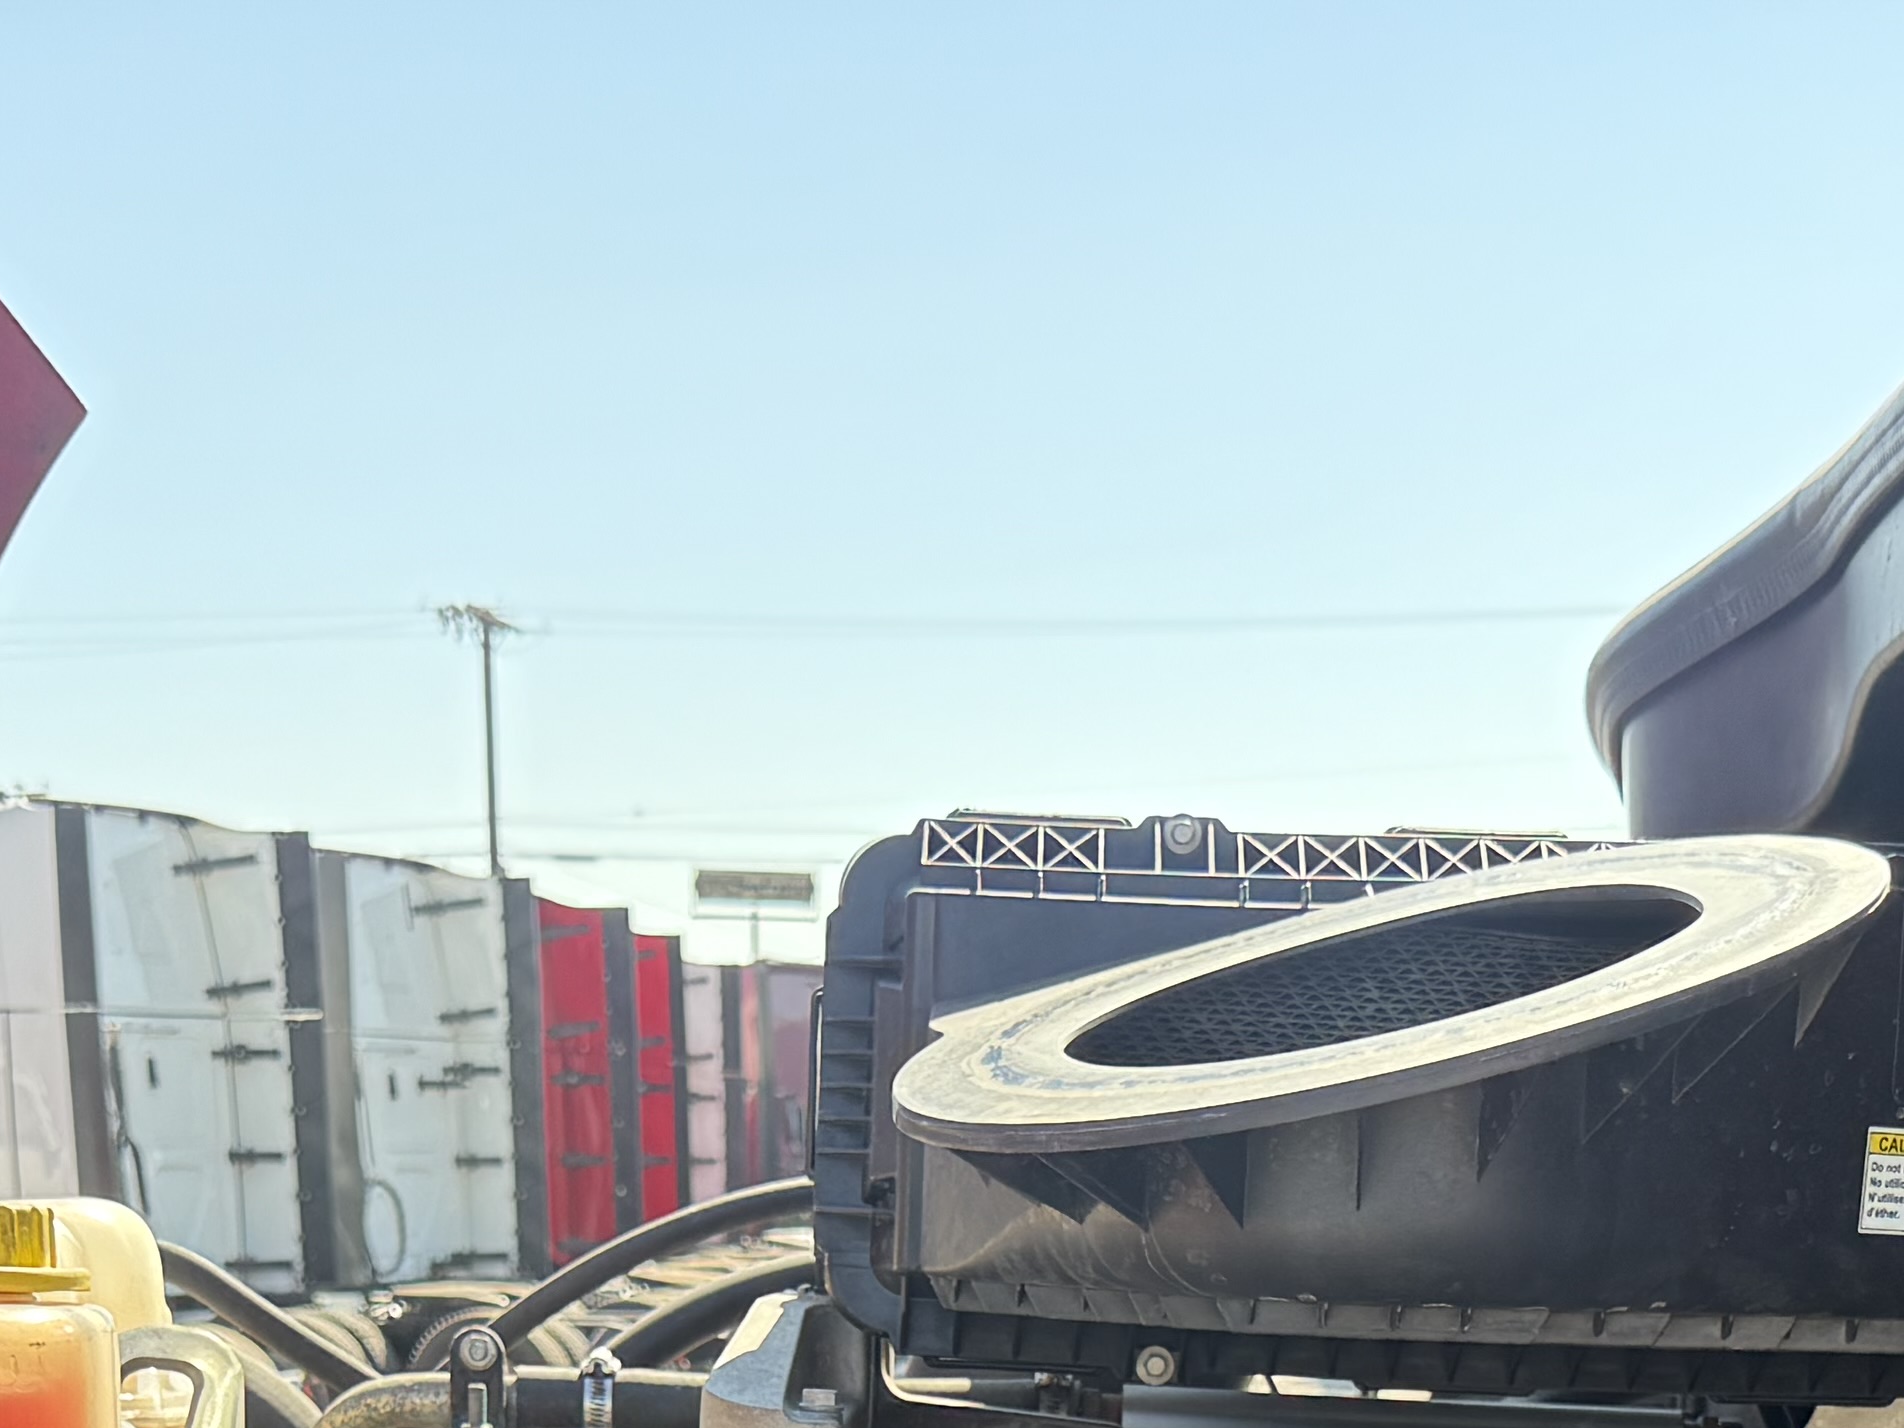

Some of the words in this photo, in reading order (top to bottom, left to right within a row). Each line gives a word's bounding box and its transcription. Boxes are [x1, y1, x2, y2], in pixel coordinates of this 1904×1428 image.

[1871, 1162, 1884, 1173] Do
[1886, 1163, 1901, 1174] not
[1870, 1177, 1882, 1187] No
